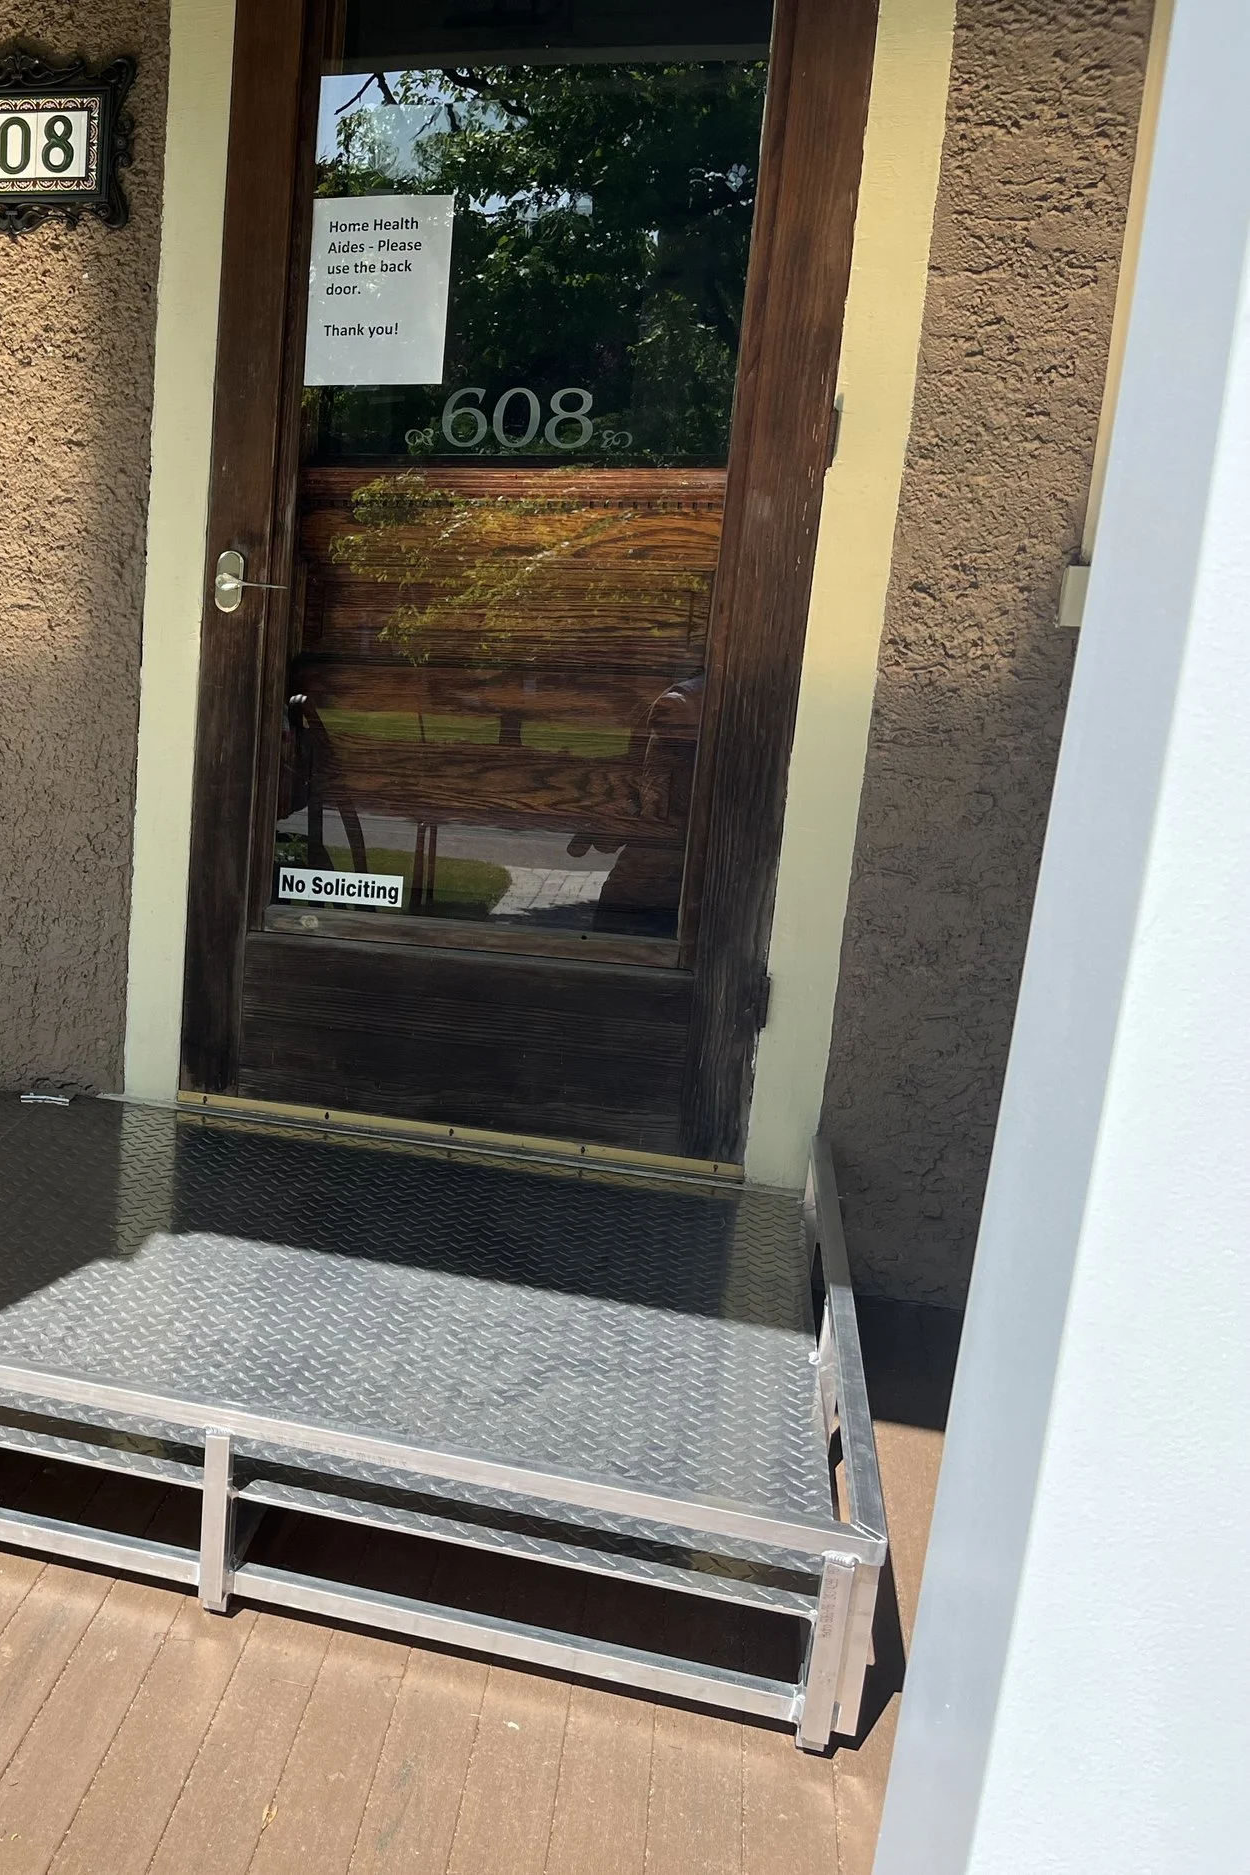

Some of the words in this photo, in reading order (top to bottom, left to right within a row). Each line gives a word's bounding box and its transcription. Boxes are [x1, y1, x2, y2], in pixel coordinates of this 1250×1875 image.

[329, 221, 369, 233] Home
[373, 217, 419, 231] Health
[327, 241, 365, 254] Aides
[378, 239, 422, 252] Please
[327, 264, 350, 275] use
[354, 261, 376, 274] the
[380, 260, 412, 273] back
[326, 283, 361, 295] door.
[324, 323, 365, 337] Thank
[368, 322, 399, 338] you!
[441, 387, 594, 449] 608
[281, 874, 306, 893] No
[311, 876, 399, 905] Soliciting
